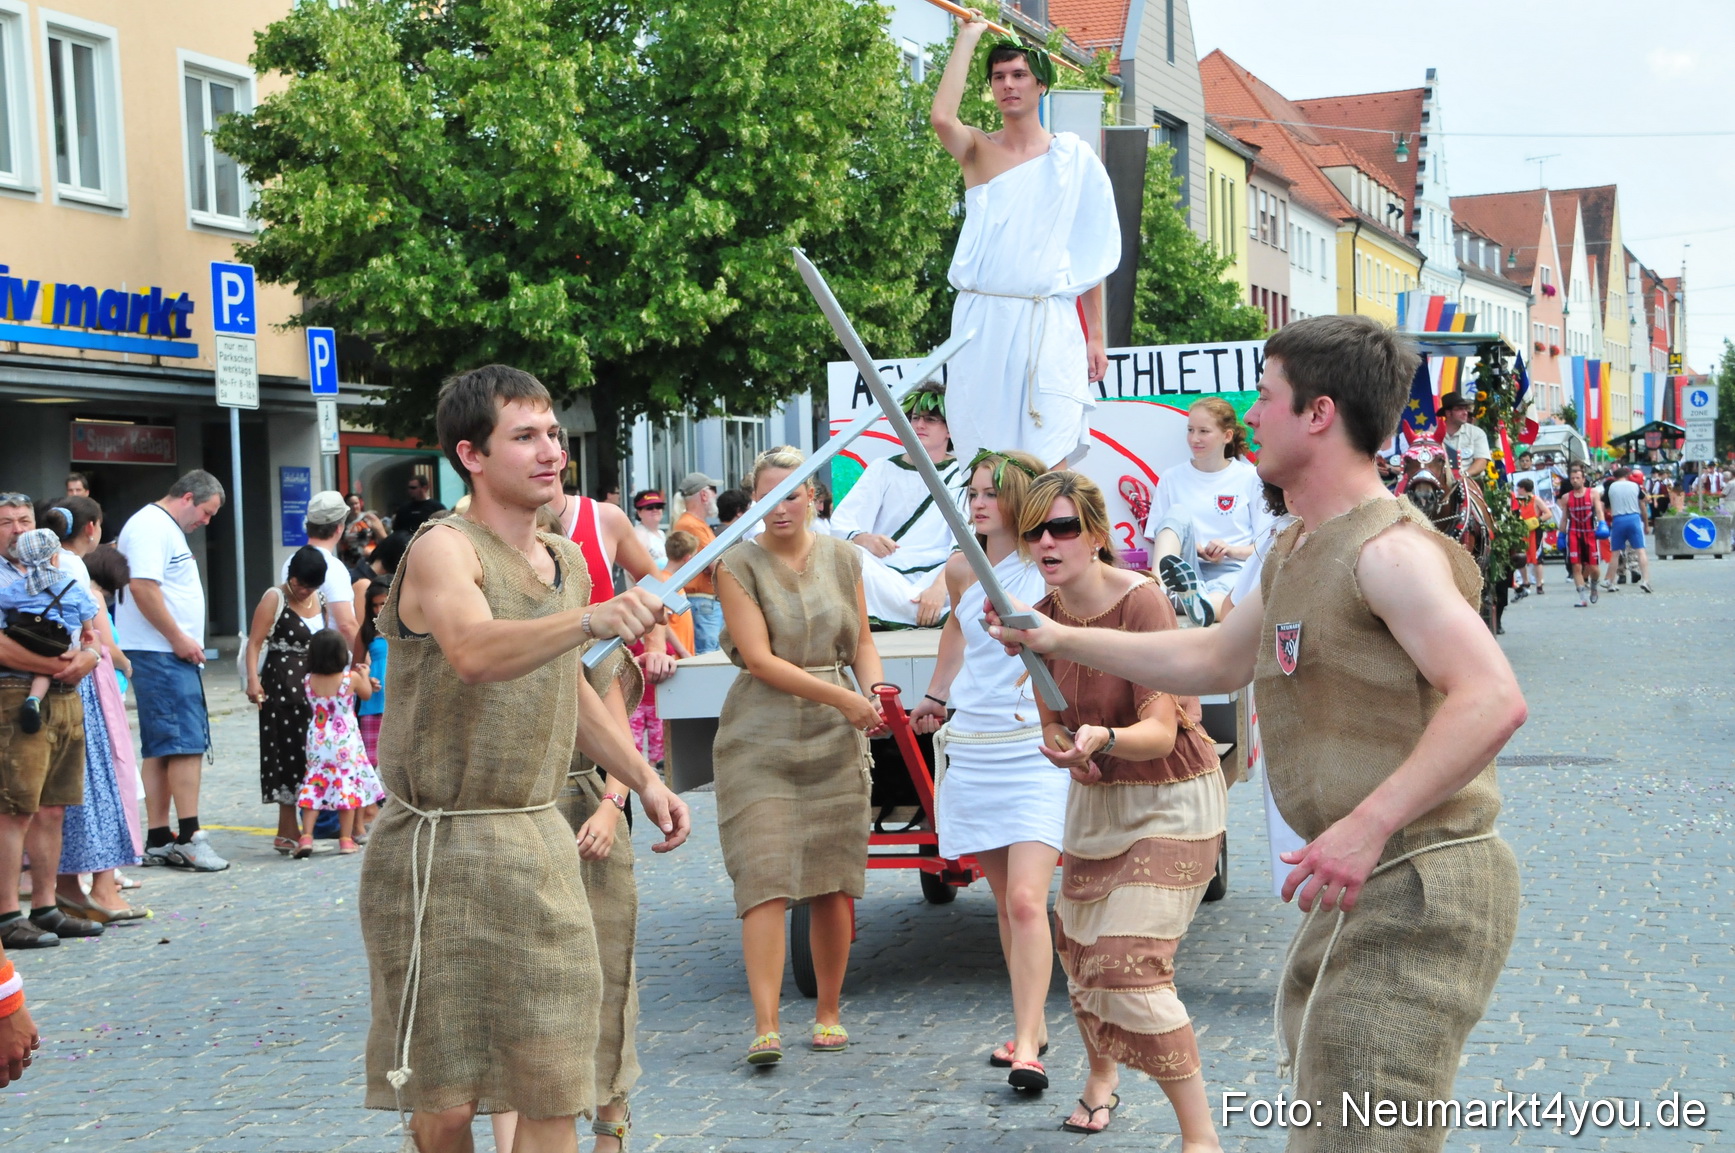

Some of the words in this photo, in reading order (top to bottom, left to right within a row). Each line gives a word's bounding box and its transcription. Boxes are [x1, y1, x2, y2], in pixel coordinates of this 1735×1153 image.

[221, 271, 246, 325] P
[46, 284, 194, 338] markt
[224, 342, 235, 350] nur
[219, 351, 254, 363] Parkschein
[313, 336, 330, 387] P
[223, 365, 252, 377] werktags
[1690, 409, 1708, 417] ZONE
[87, 428, 126, 459] Super
